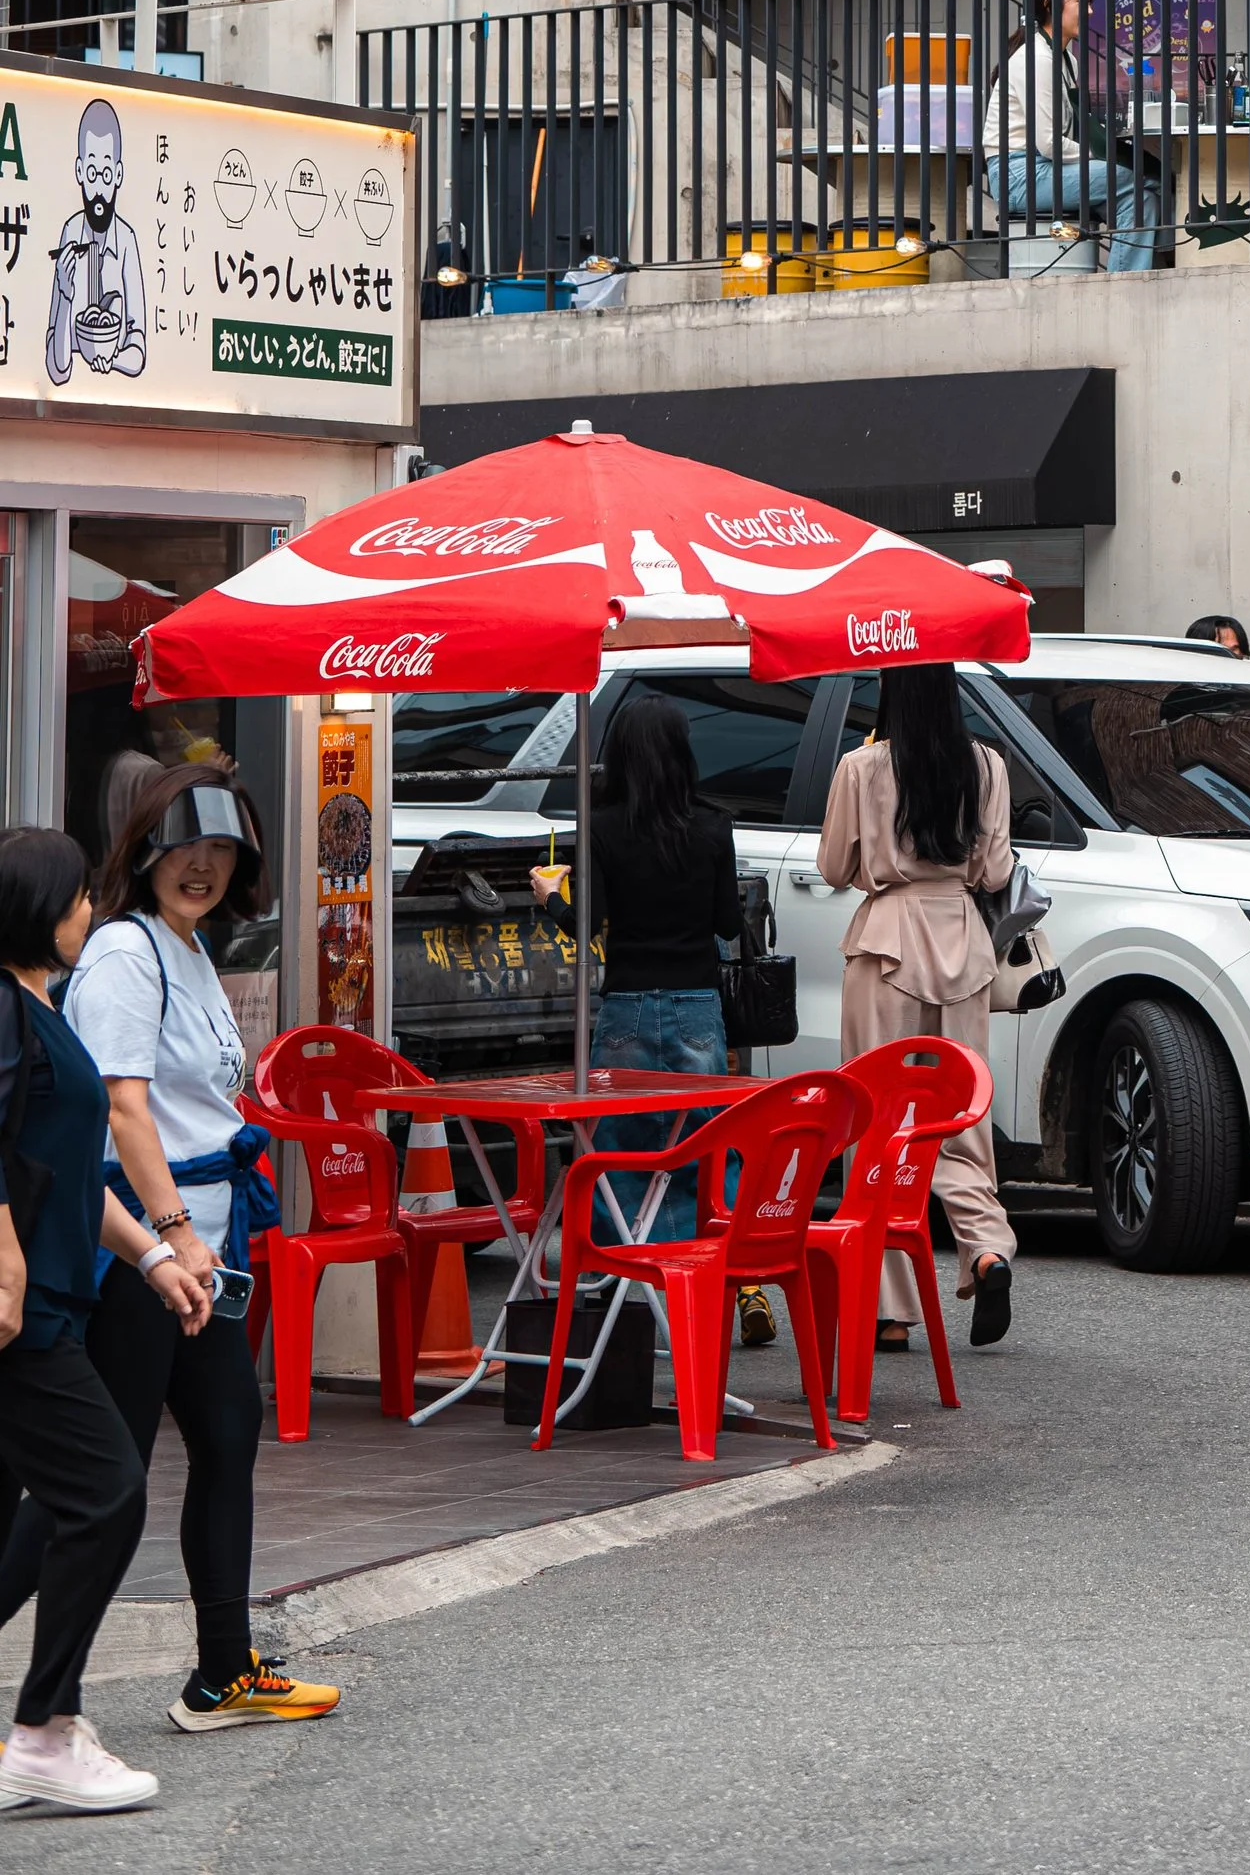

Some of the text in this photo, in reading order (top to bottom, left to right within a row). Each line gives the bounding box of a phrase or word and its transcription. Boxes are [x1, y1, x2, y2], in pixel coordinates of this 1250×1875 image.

[1115, 0, 1155, 30] Fod
[223, 160, 247, 179] うどん
[213, 249, 394, 313] いらっしゃいませ
[953, 490, 983, 517] 롭다
[349, 514, 566, 558] Coca-Cola
[703, 505, 842, 550] Coca-Cola
[845, 608, 920, 658] Coca-Cola
[318, 631, 449, 681] Coca-Cola
[321, 1150, 366, 1178] Coca-Cola
[755, 1197, 800, 1220] Coca-Cola
